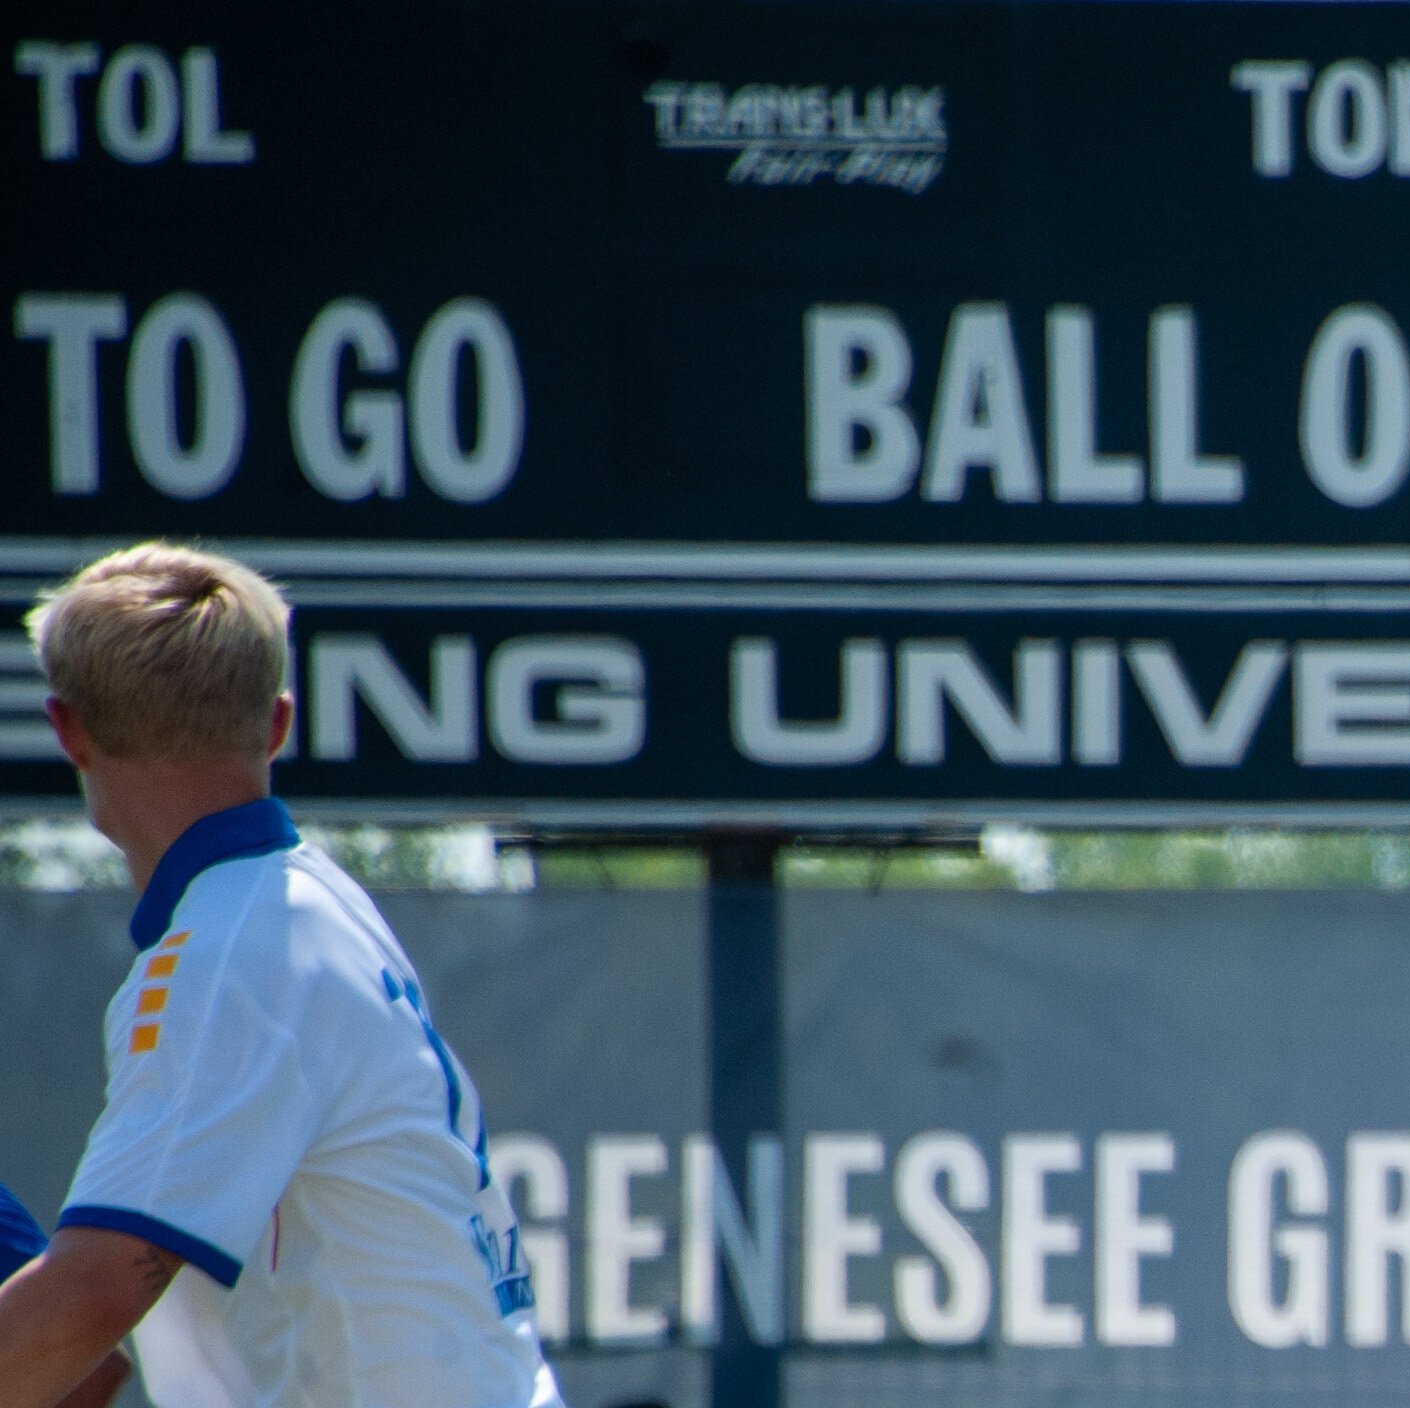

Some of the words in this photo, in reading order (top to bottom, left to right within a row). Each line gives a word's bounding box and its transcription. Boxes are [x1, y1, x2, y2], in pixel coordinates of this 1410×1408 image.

[16, 42, 254, 164] TOL
[15, 294, 246, 498] TO
[289, 299, 525, 502] GO
[806, 305, 1245, 503] BALL
[486, 1132, 1178, 1347] GENESEE
